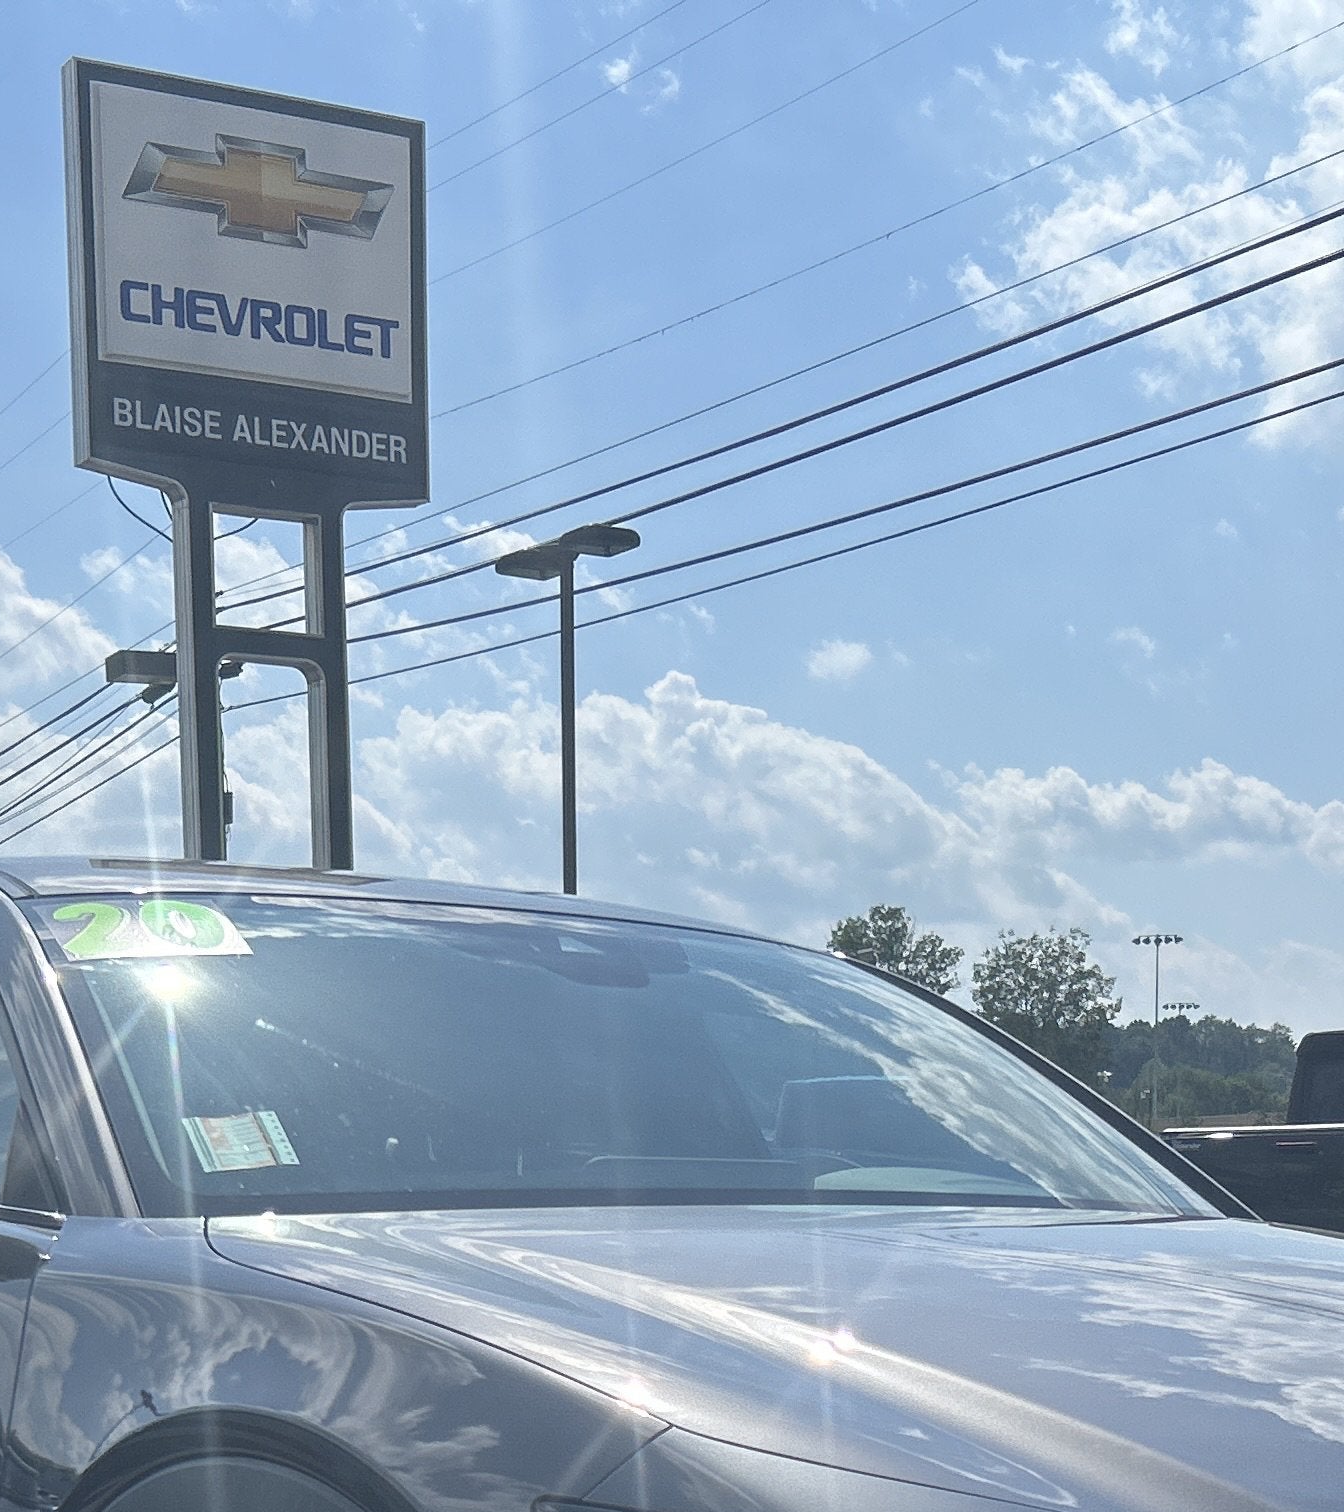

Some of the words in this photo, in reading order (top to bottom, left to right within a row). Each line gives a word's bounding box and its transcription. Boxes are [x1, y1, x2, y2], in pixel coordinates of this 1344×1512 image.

[120, 279, 400, 359] CHEVROLET
[113, 396, 223, 440] BLAISE
[232, 414, 407, 464] ALEXANDER
[52, 899, 225, 958] 20
